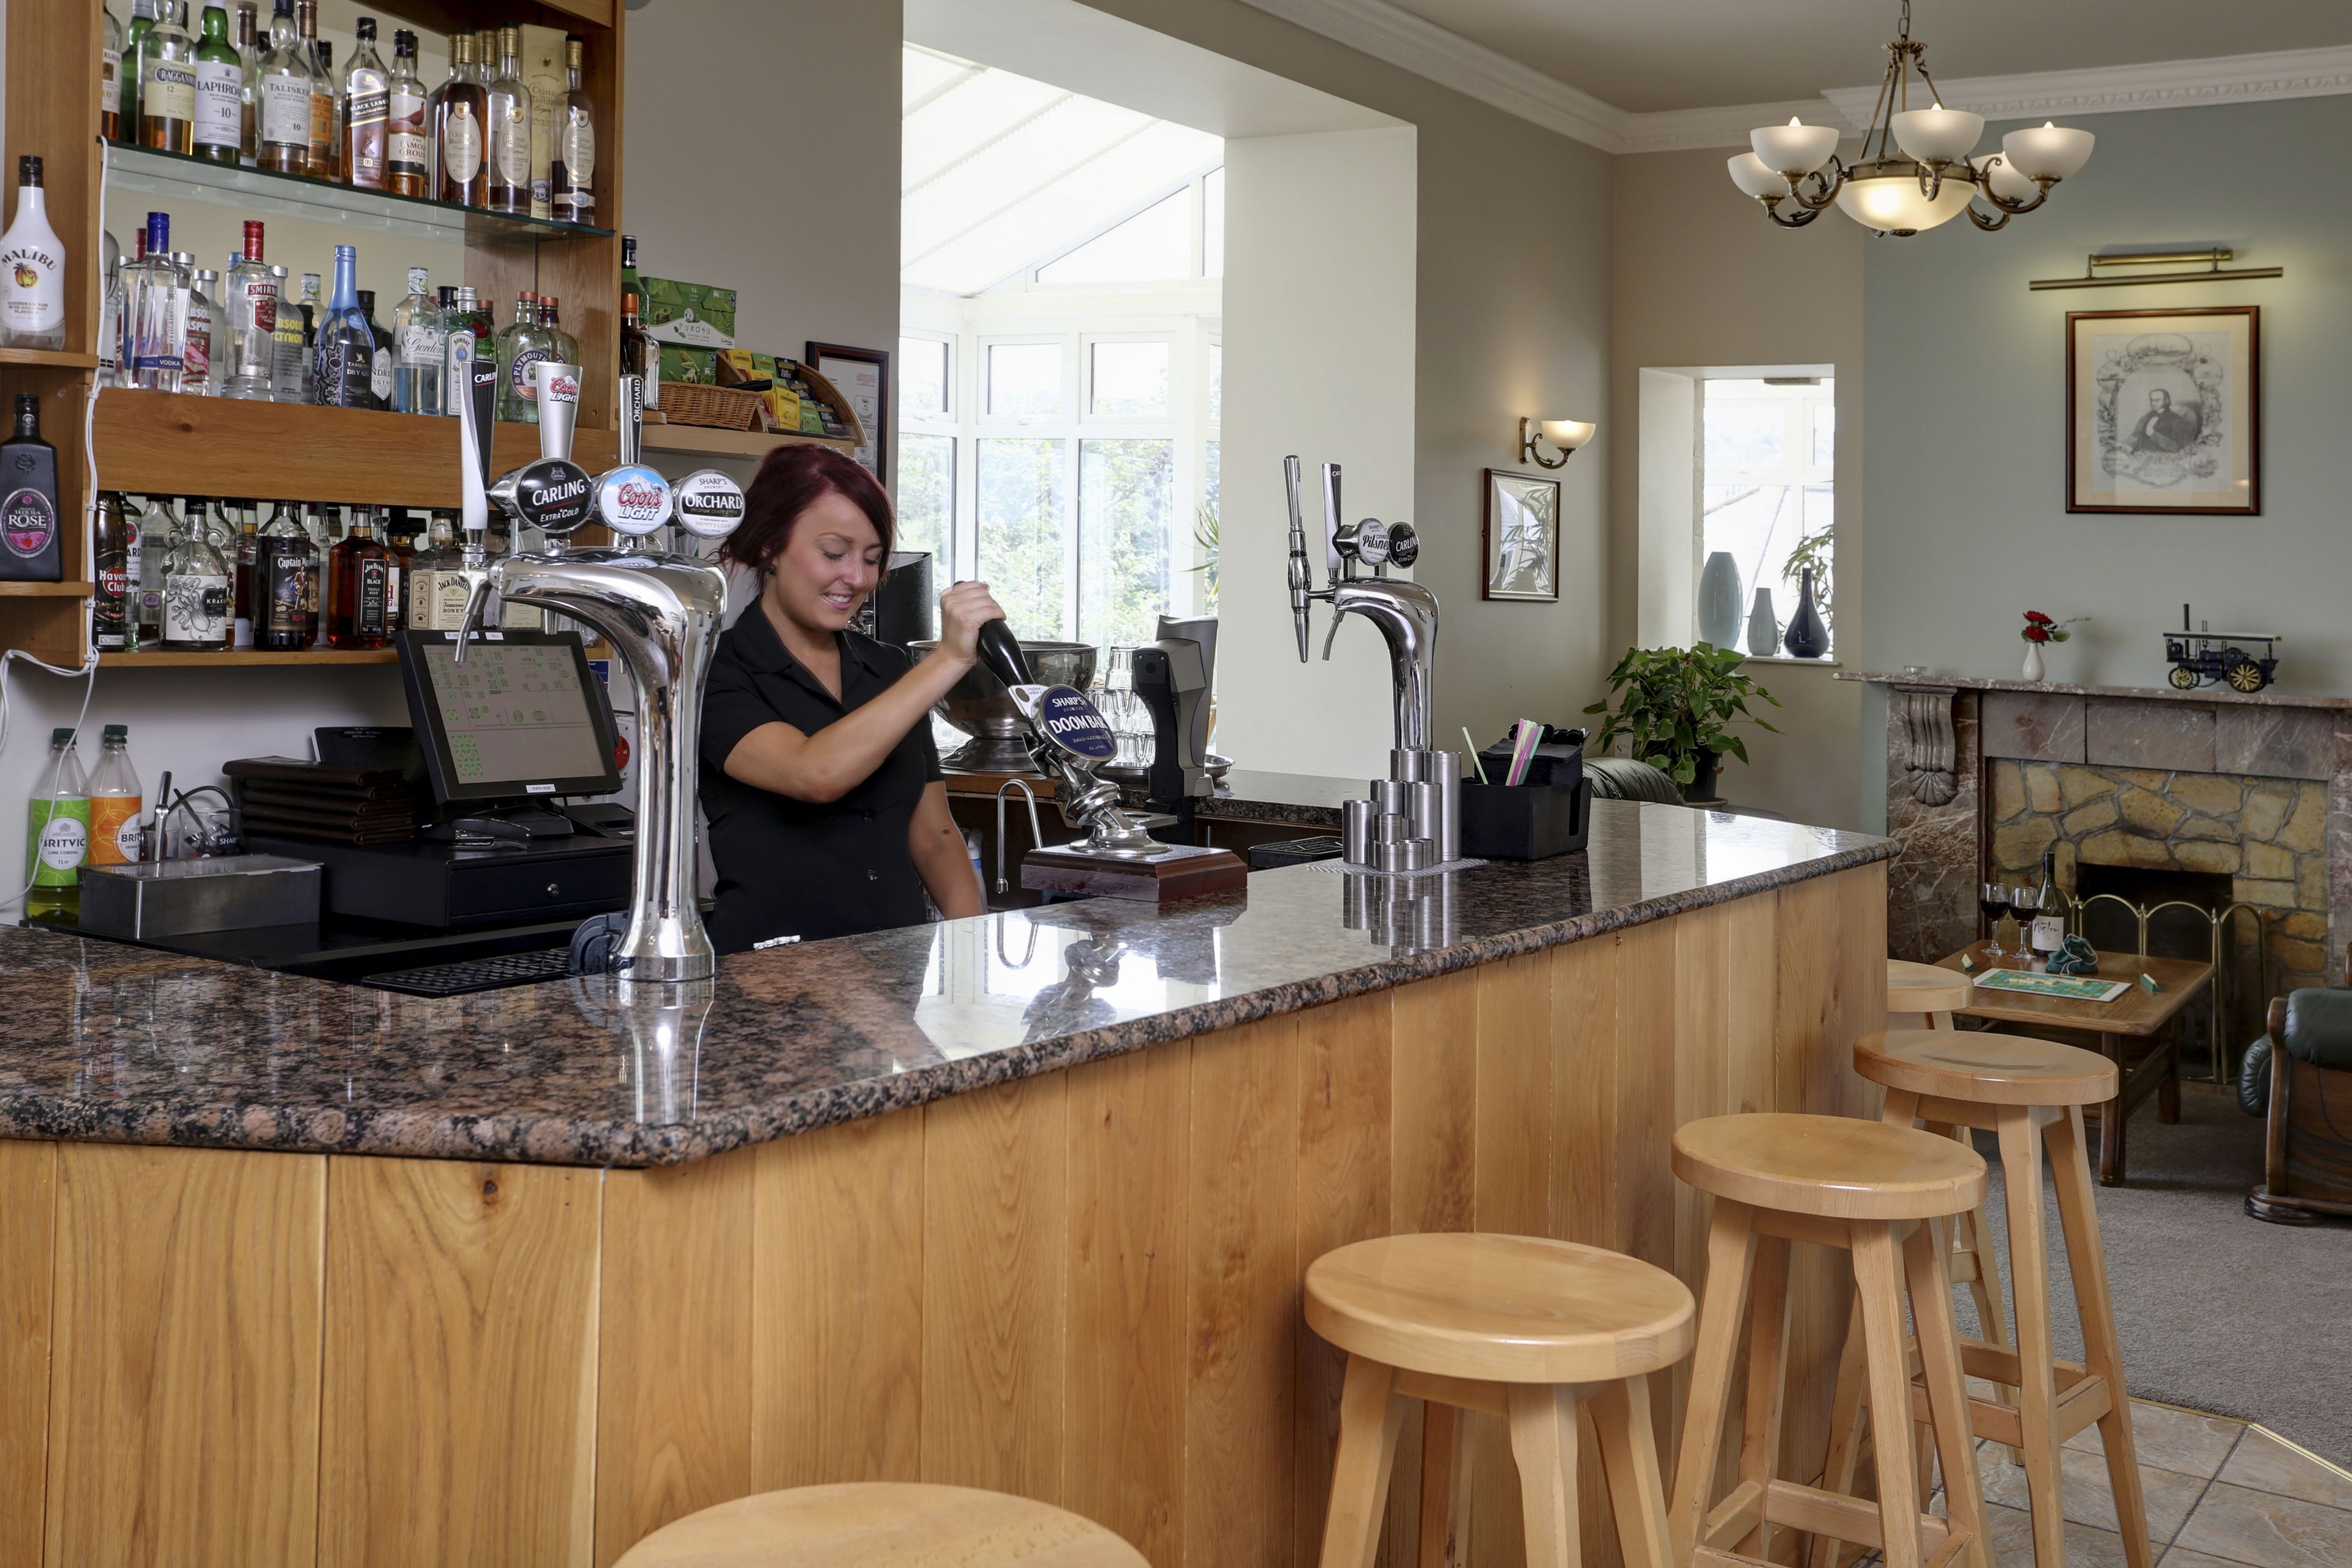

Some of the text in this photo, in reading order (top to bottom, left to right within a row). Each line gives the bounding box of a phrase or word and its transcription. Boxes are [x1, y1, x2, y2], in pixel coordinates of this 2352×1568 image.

[221, 107, 232, 118] 10
[1, 249, 58, 271] MALIBU
[453, 337, 470, 347] BOMBAY
[532, 479, 587, 506] CARLING
[617, 482, 662, 508] Coors
[685, 494, 743, 510] ORCHARD
[617, 506, 660, 521] LIGHT
[8, 514, 47, 527] ROSE
[277, 557, 301, 569] Captain
[364, 563, 383, 573] JIM BEAM
[438, 579, 451, 591] JACK
[1052, 697, 1084, 707] SHARP'S
[1048, 715, 1109, 734] DOOM BAR
[121, 833, 141, 843] BRIT
